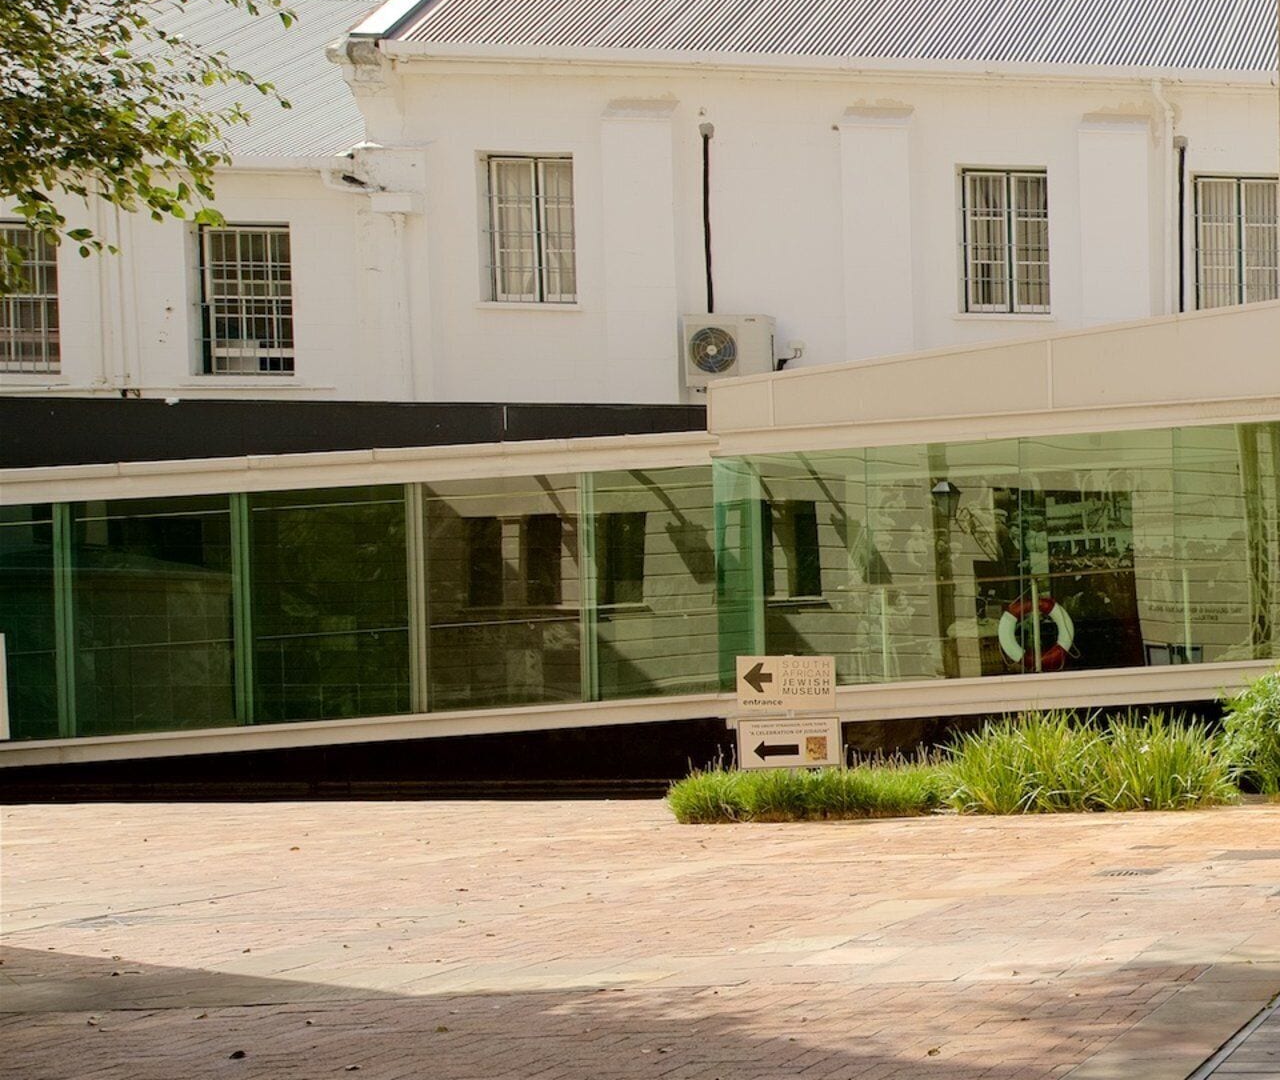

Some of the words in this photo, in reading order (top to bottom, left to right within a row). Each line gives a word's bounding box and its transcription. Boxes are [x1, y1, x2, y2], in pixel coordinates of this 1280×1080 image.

[782, 660, 830, 669] SOUTH
[782, 669, 830, 678] AFRICAN
[782, 678, 830, 687] JEWISH
[782, 687, 830, 696] MUSEUM
